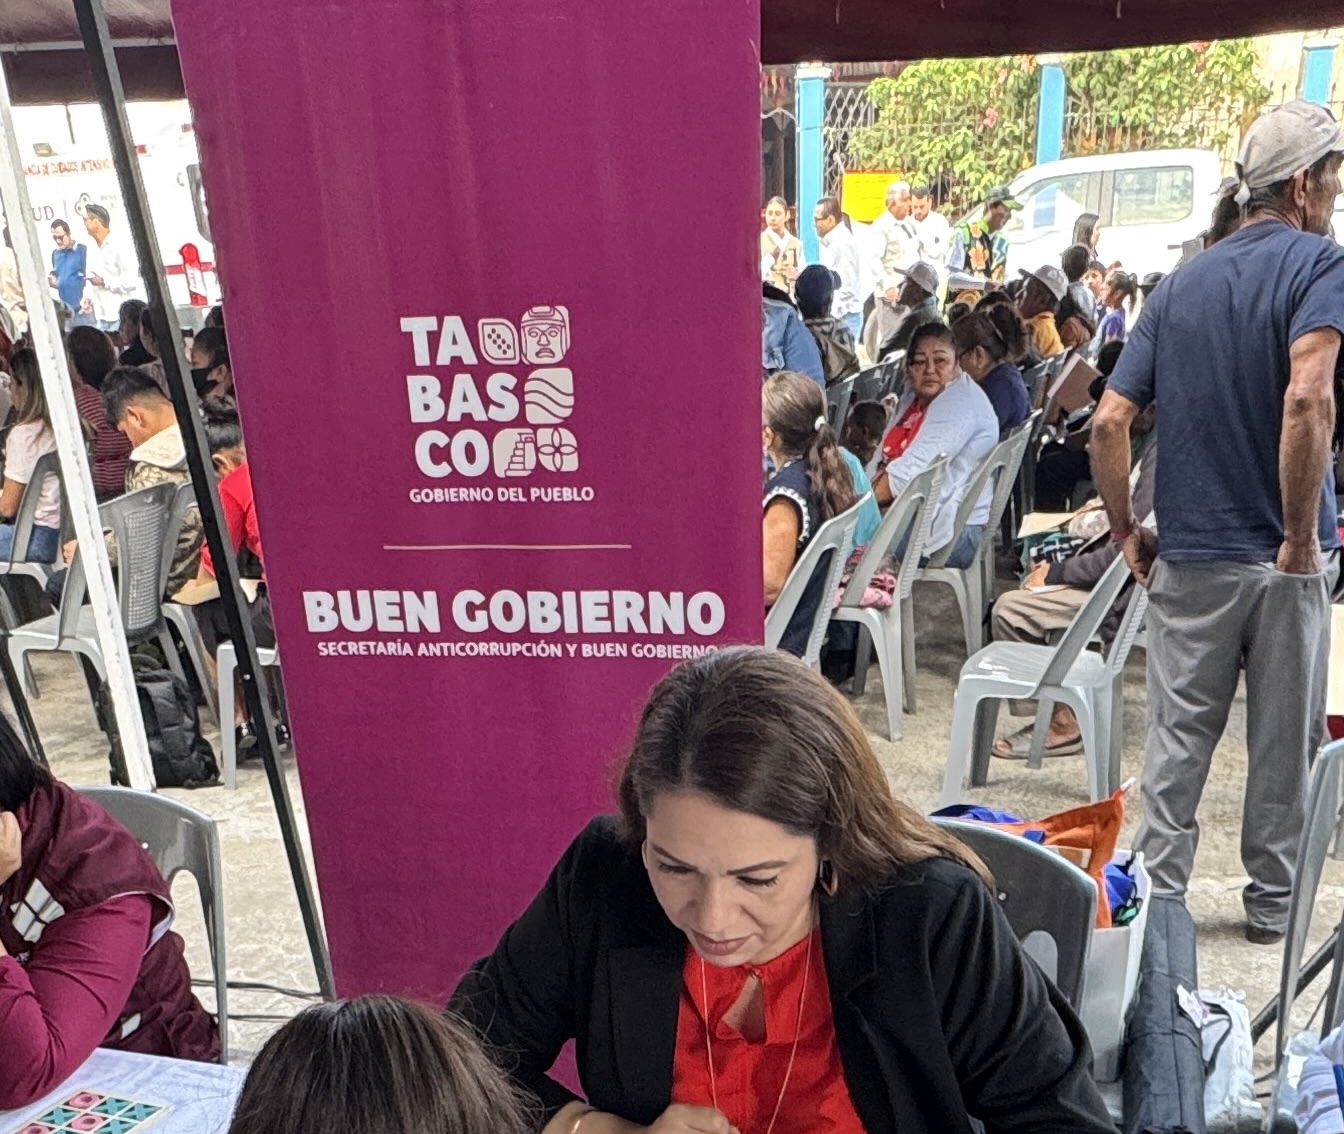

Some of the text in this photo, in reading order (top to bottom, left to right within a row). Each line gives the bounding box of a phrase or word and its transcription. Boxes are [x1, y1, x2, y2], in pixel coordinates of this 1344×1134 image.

[409, 486, 595, 503] GOBIERNO DEL PUEBLO
[302, 589, 726, 636] BUEN GOBIERNO
[317, 639, 414, 657] SECRETARÍA
[417, 639, 562, 657] ANTICORRUPCIÓN
[565, 643, 577, 658] Y
[582, 643, 627, 658] BUEN
